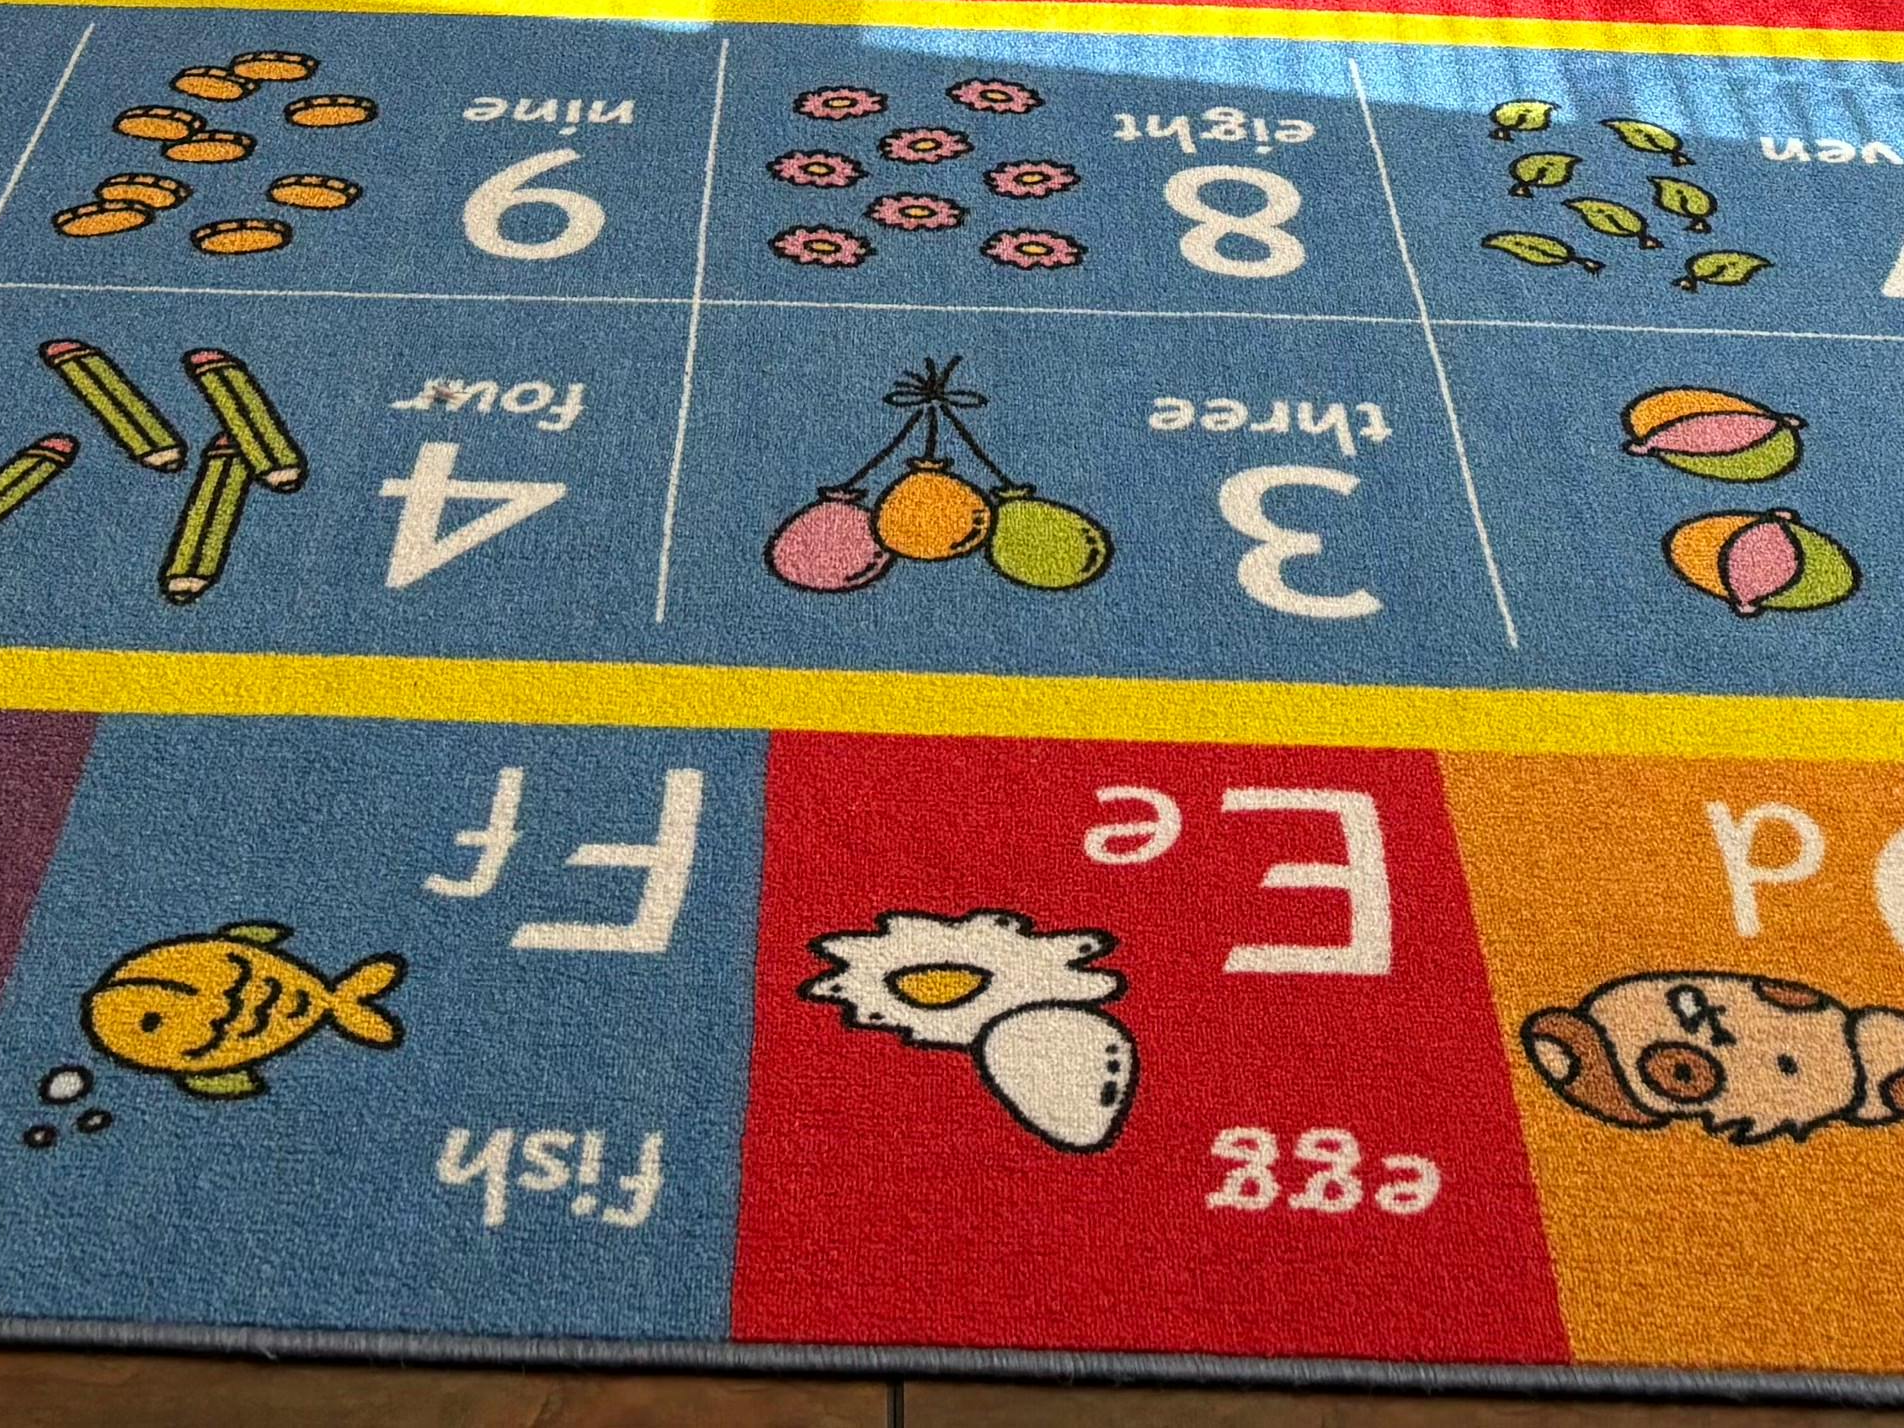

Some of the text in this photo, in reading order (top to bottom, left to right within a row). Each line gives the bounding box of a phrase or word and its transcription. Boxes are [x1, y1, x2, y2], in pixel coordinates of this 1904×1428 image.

[463, 97, 634, 135] nine
[1114, 106, 1315, 154] eight
[462, 148, 605, 261] 9
[1164, 165, 1306, 278] 8
[391, 378, 584, 426] four
[1148, 397, 1392, 457] three
[379, 442, 567, 589] 4
[1218, 464, 1382, 619] 3
[436, 1128, 664, 1228] fish
[1206, 1127, 1441, 1215] egg
